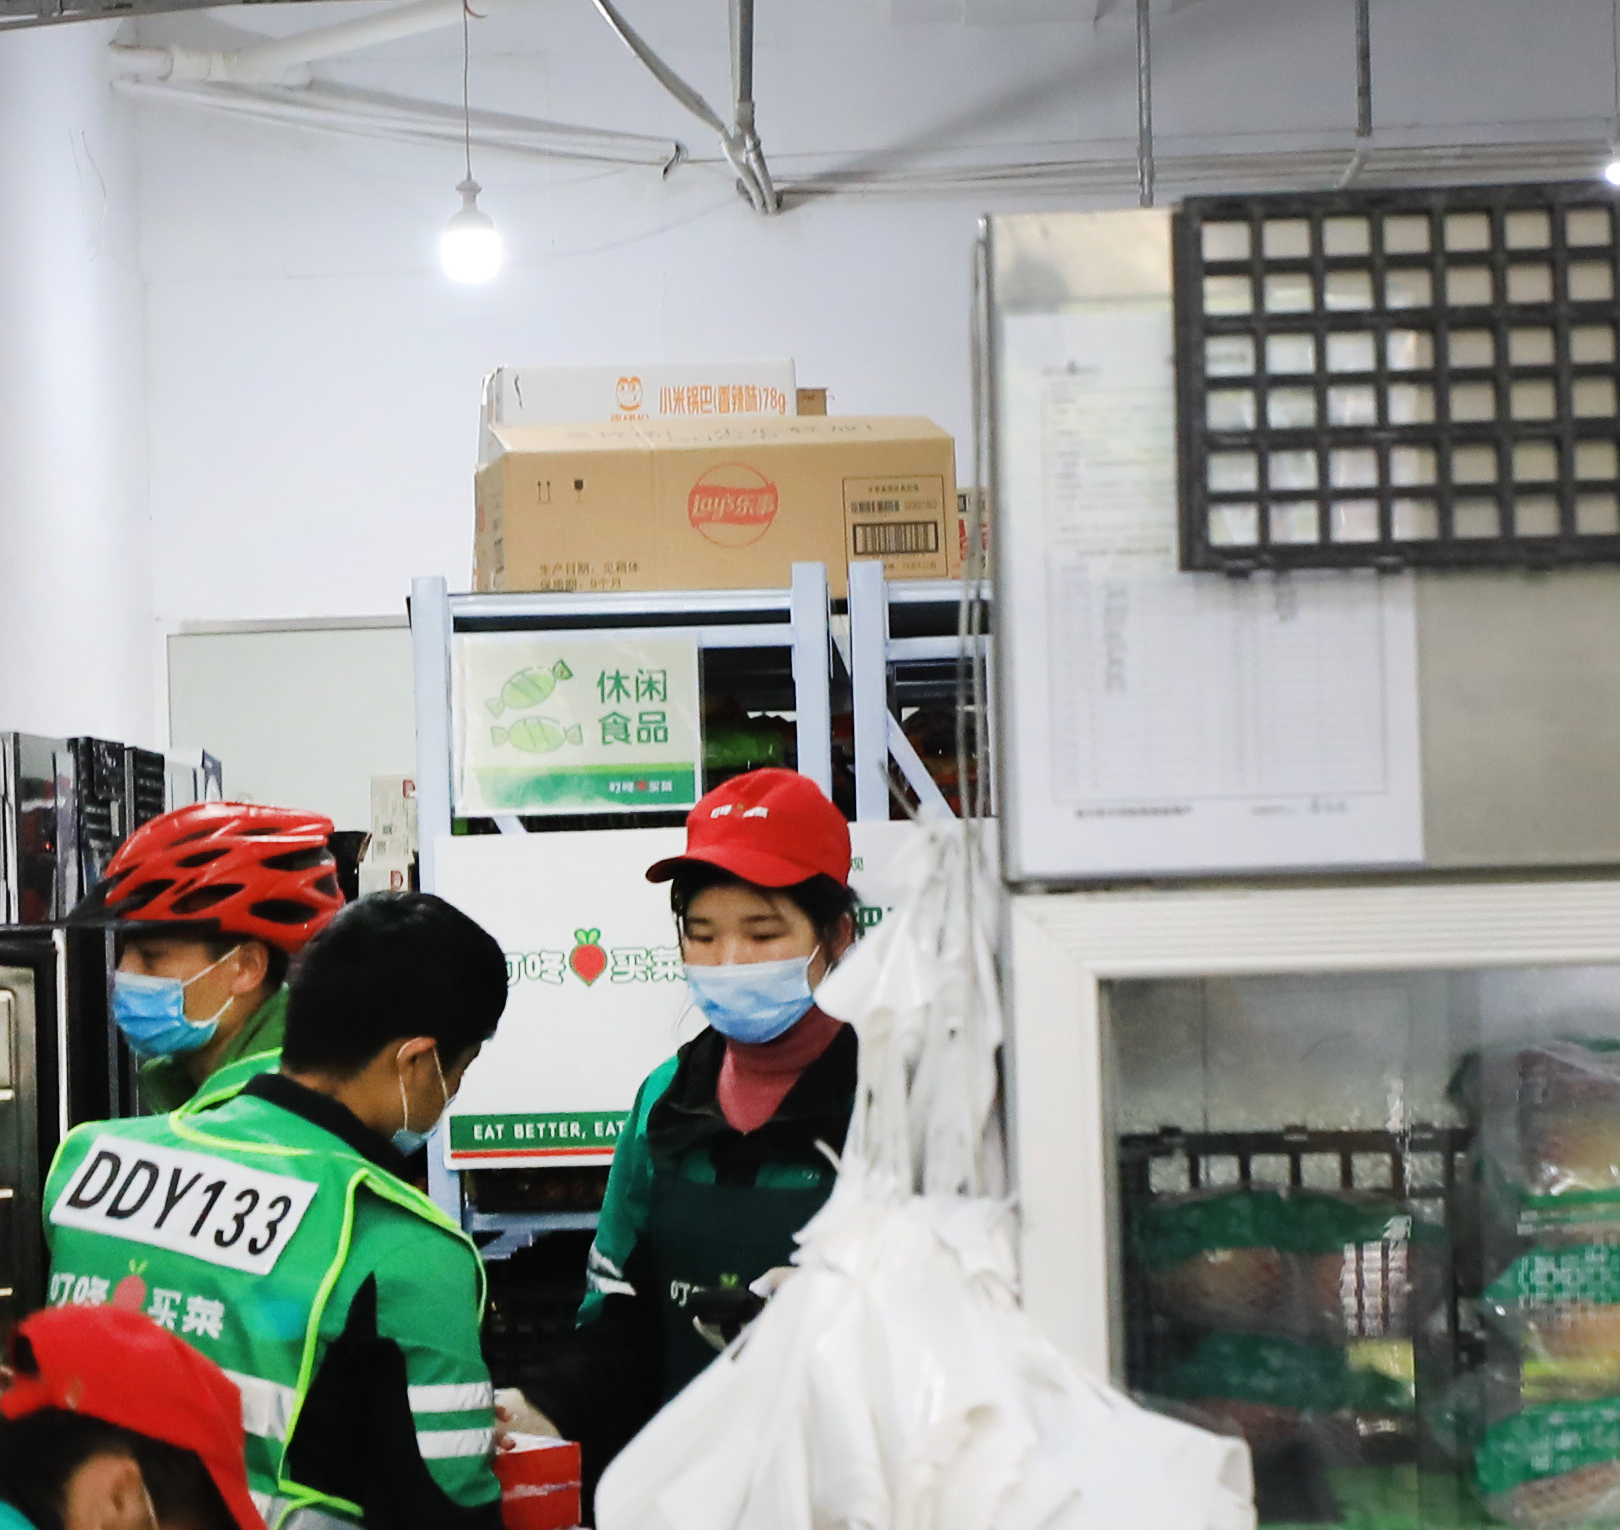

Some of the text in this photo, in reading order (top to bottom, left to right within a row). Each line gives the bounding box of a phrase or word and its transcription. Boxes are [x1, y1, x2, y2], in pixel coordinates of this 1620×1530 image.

[597, 668, 667, 704] 休闲
[598, 711, 668, 746] 食品
[610, 944, 687, 984] 买菜
[473, 1121, 624, 1140] EAT BETTER, EAT
[65, 1150, 292, 1256] DDY133
[147, 1287, 225, 1340] 买菜
